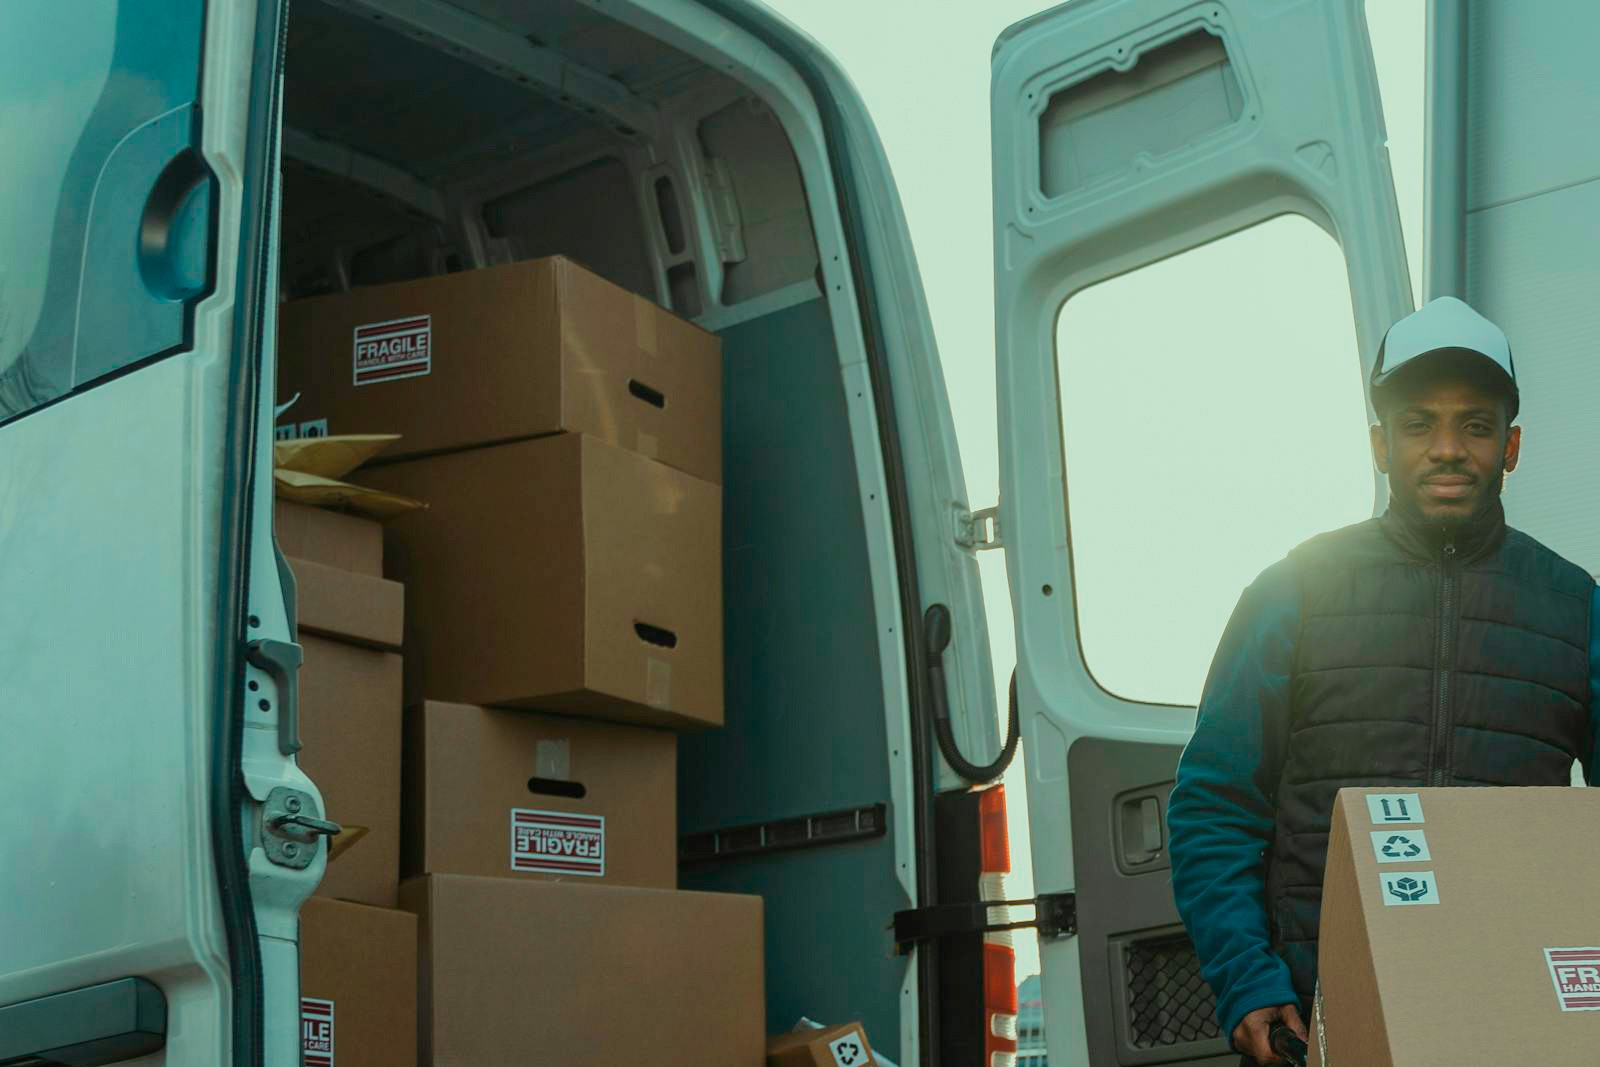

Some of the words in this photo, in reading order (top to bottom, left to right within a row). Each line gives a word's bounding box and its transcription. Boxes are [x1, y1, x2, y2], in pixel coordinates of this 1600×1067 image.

[357, 334, 427, 360] FRAGILE
[517, 836, 600, 857] FRAGILE
[565, 831, 601, 841] HANDLE
